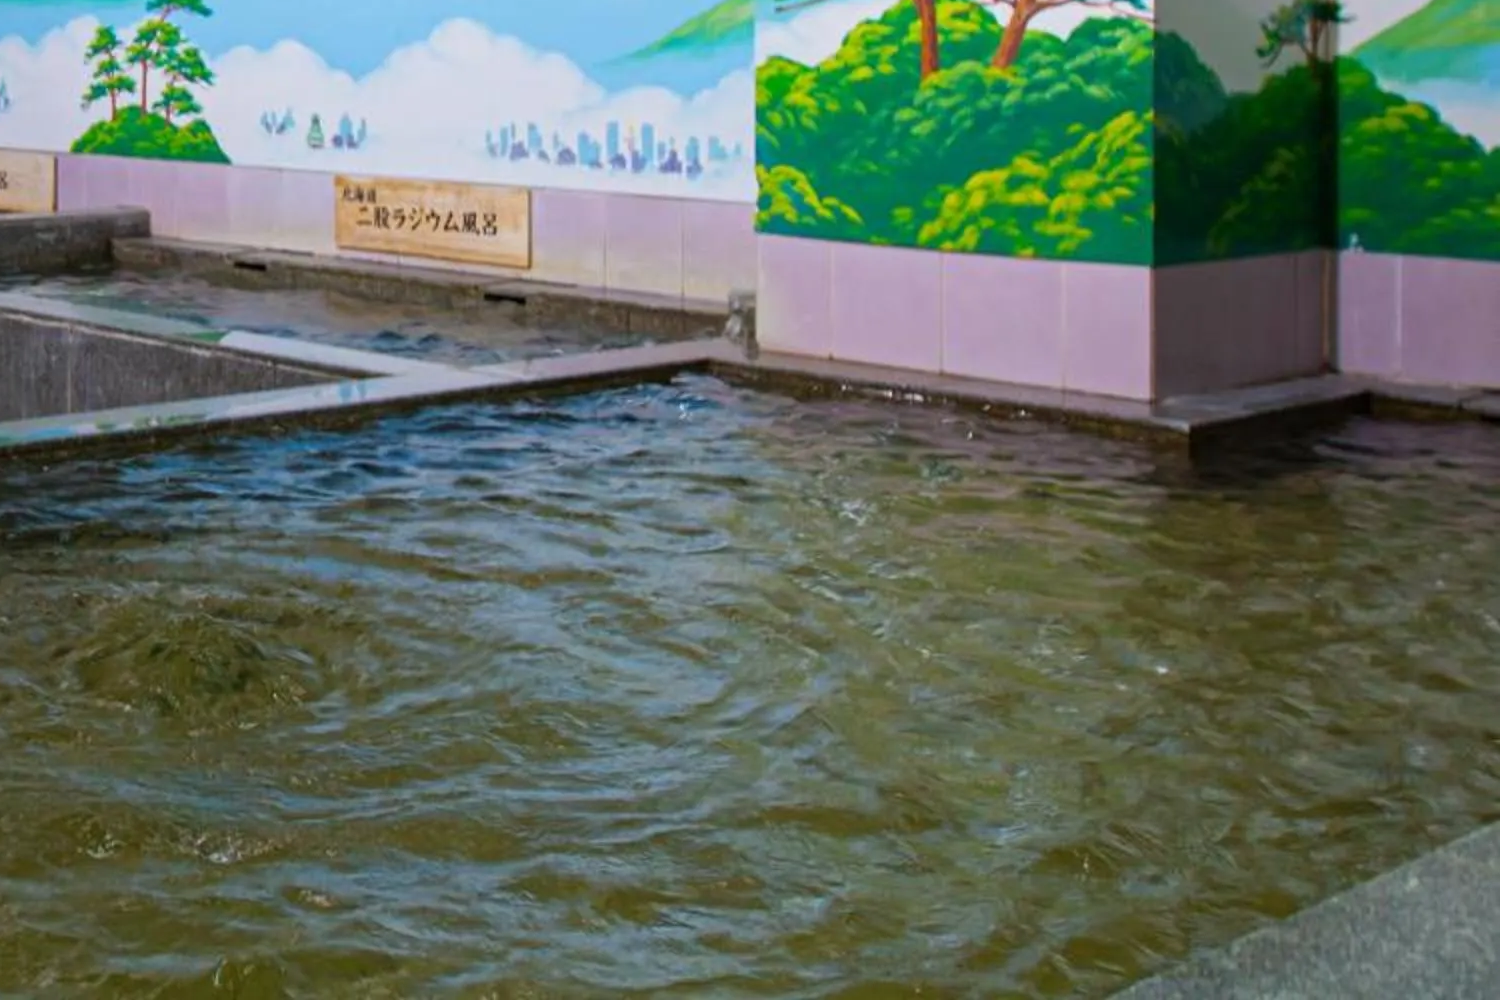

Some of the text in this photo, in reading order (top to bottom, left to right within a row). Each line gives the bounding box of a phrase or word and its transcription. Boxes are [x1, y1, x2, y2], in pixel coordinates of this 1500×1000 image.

[356, 205, 498, 236] 二股ラジウム風呂
